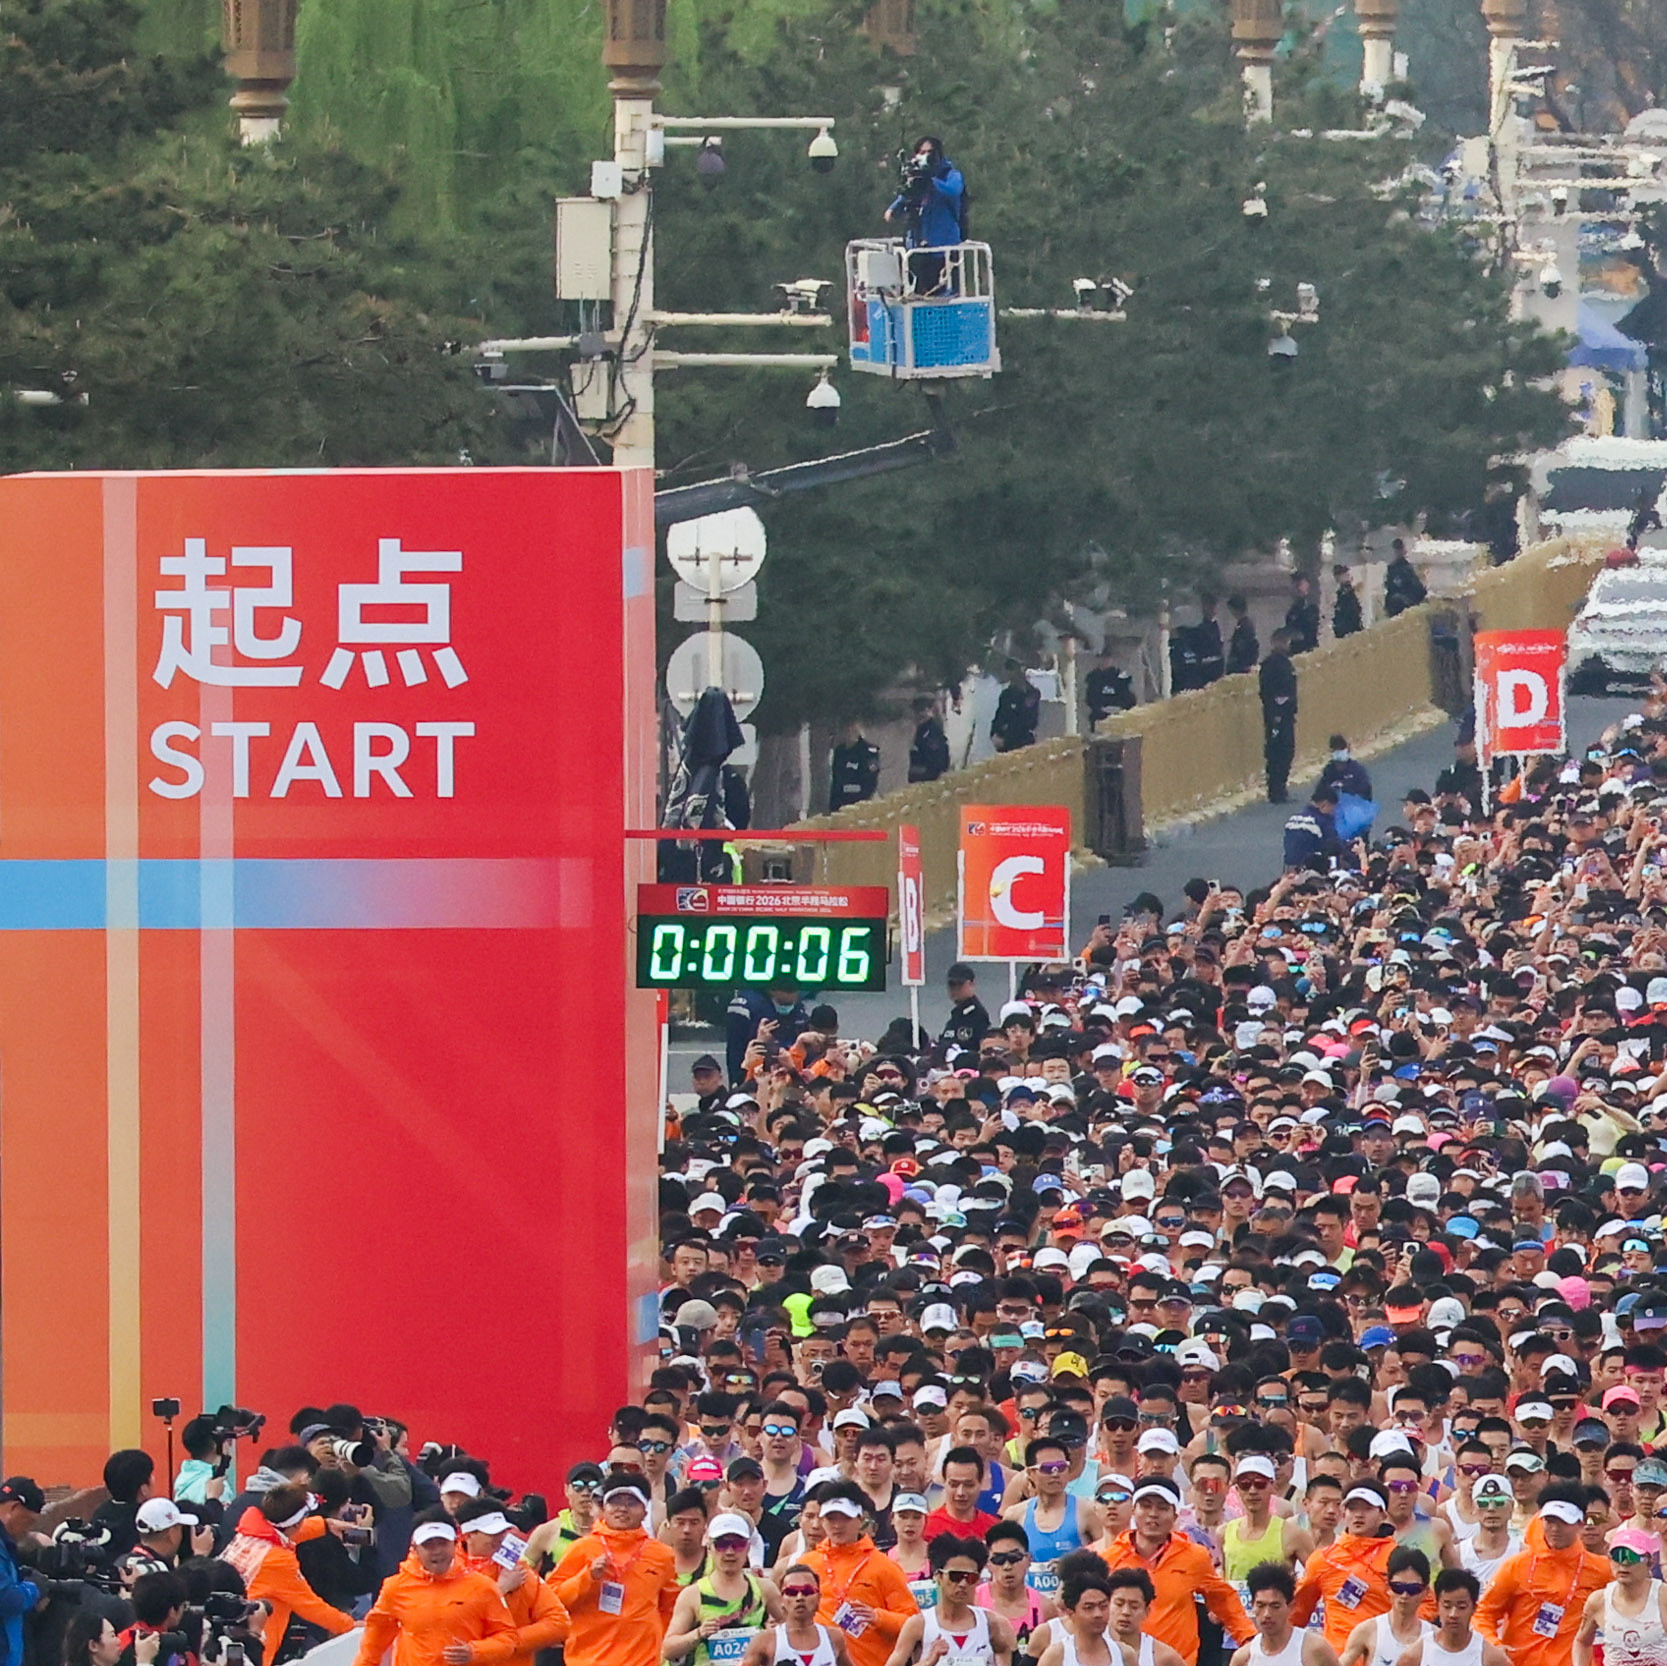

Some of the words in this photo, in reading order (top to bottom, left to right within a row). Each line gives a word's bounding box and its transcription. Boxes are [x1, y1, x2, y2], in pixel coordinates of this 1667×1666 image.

[152, 537, 470, 690] 起点
[1496, 668, 1548, 730] D
[148, 720, 476, 800] START
[989, 853, 1046, 930] C
[649, 924, 871, 983] 0:00:06
